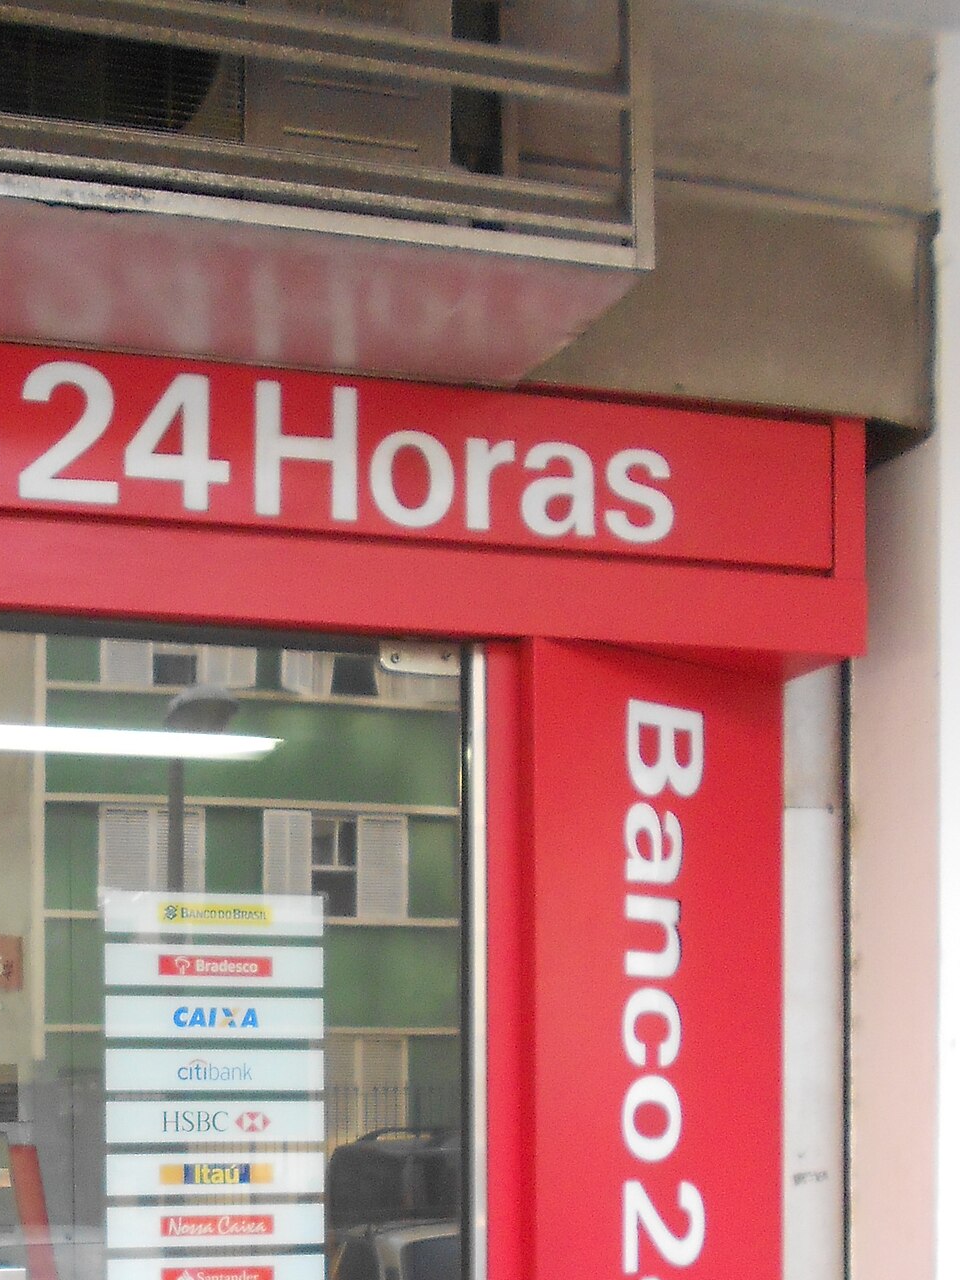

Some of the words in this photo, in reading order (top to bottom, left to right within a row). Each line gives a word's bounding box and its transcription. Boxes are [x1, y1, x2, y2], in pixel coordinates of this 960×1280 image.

[195, 959, 259, 973] Bradesco
[173, 1006, 260, 1029] CAIXA
[177, 1061, 253, 1081] citibank
[162, 1111, 229, 1133] HSBC
[194, 1164, 241, 1185] Itaú
[168, 1218, 214, 1235] Nossa
[217, 1216, 267, 1234] Caixa
